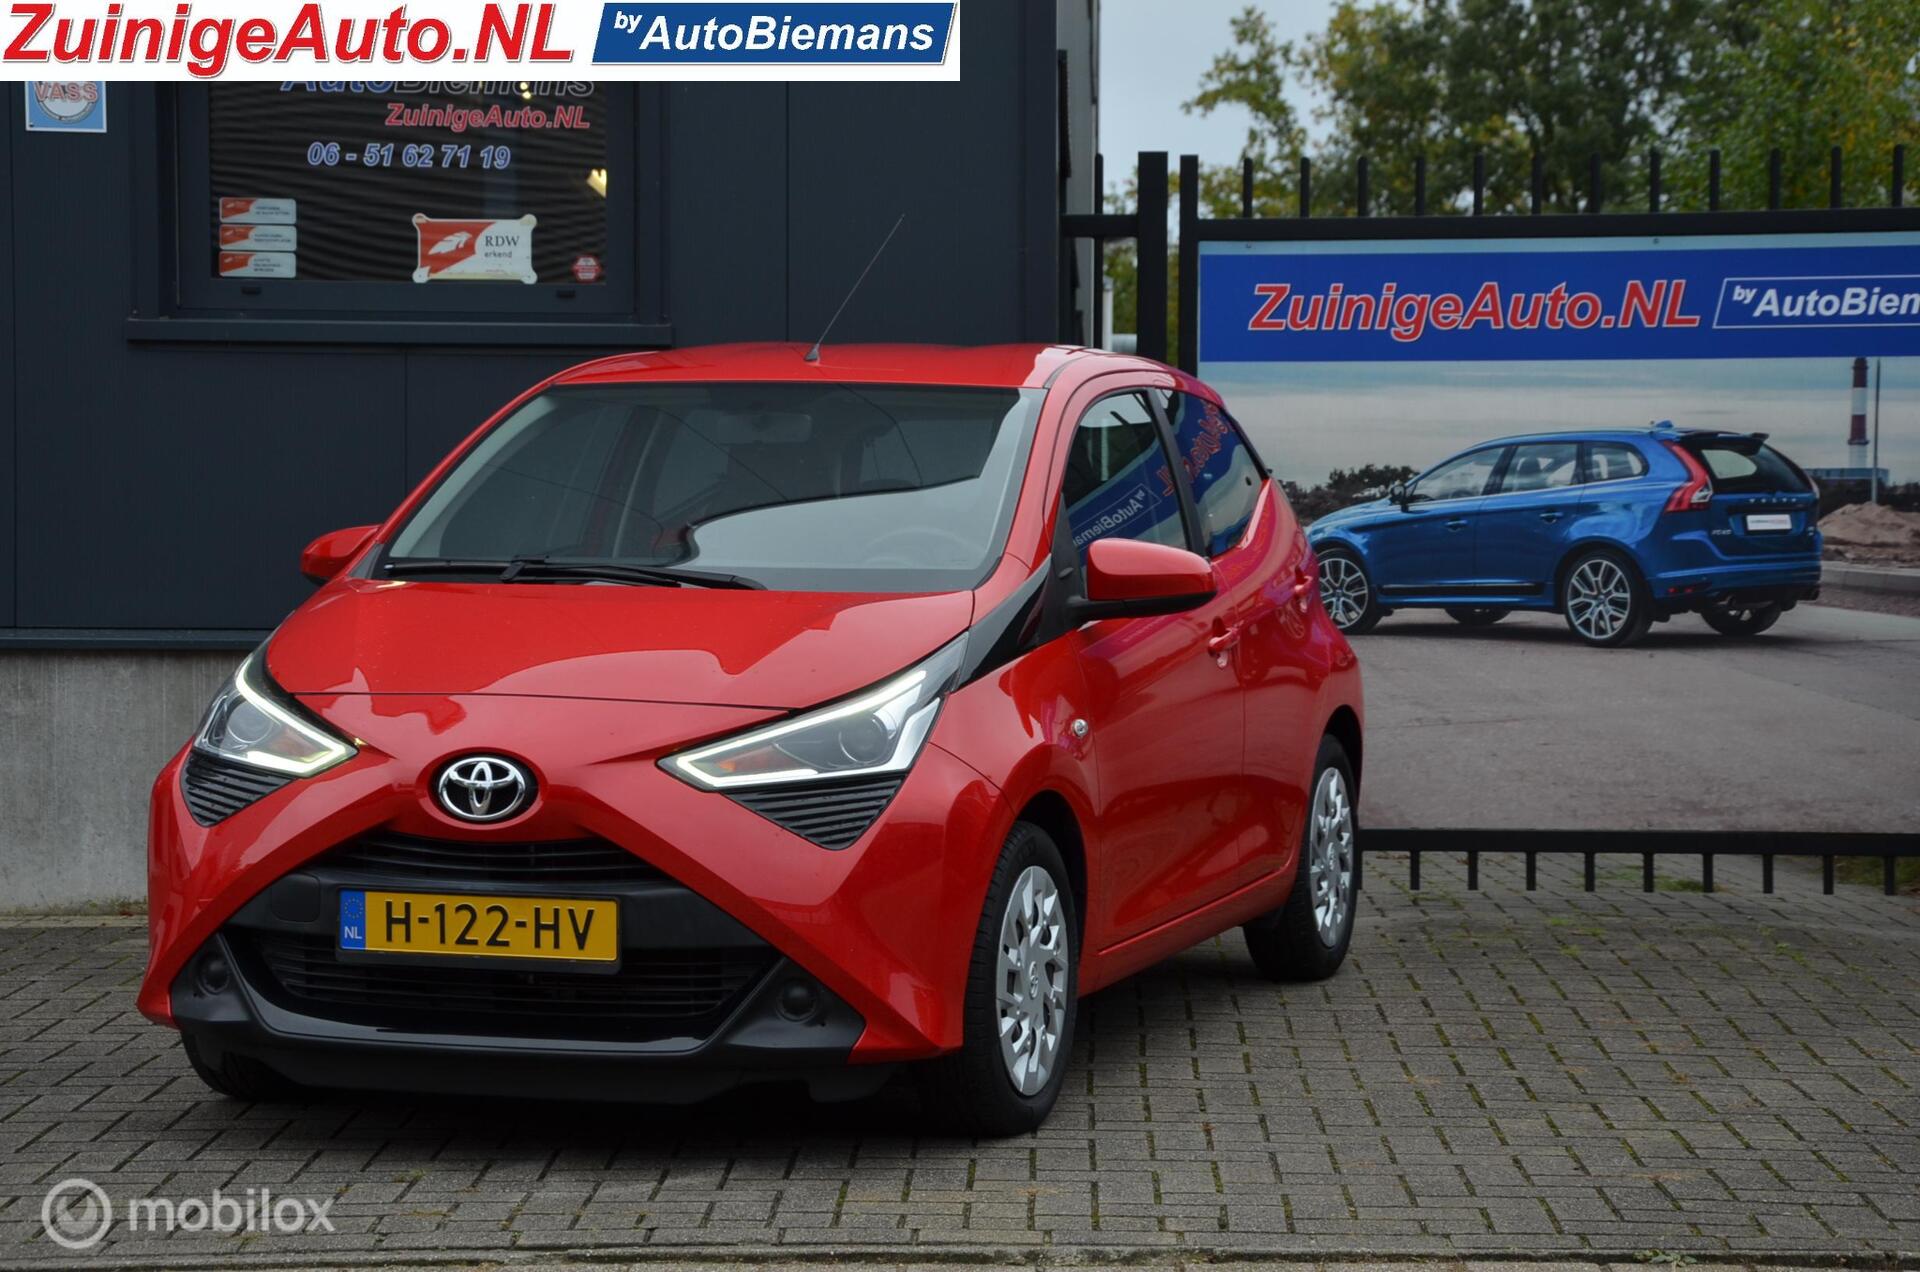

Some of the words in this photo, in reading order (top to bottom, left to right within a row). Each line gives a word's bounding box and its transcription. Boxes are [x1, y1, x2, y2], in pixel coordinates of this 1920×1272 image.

[34, 81, 98, 102] VASS
[385, 103, 590, 132] ZuinigeAuto.NL
[307, 142, 340, 166] 06
[363, 143, 394, 166] 51
[402, 144, 434, 167] 62
[441, 145, 471, 168] 71
[480, 146, 511, 169] 19
[485, 235, 520, 247] RDW
[484, 250, 512, 258] erkend
[1732, 285, 1757, 304] by
[1248, 280, 1700, 342] ZuinigeAuto.NL
[344, 926, 362, 940] NL
[385, 899, 596, 951] H-122-HV
